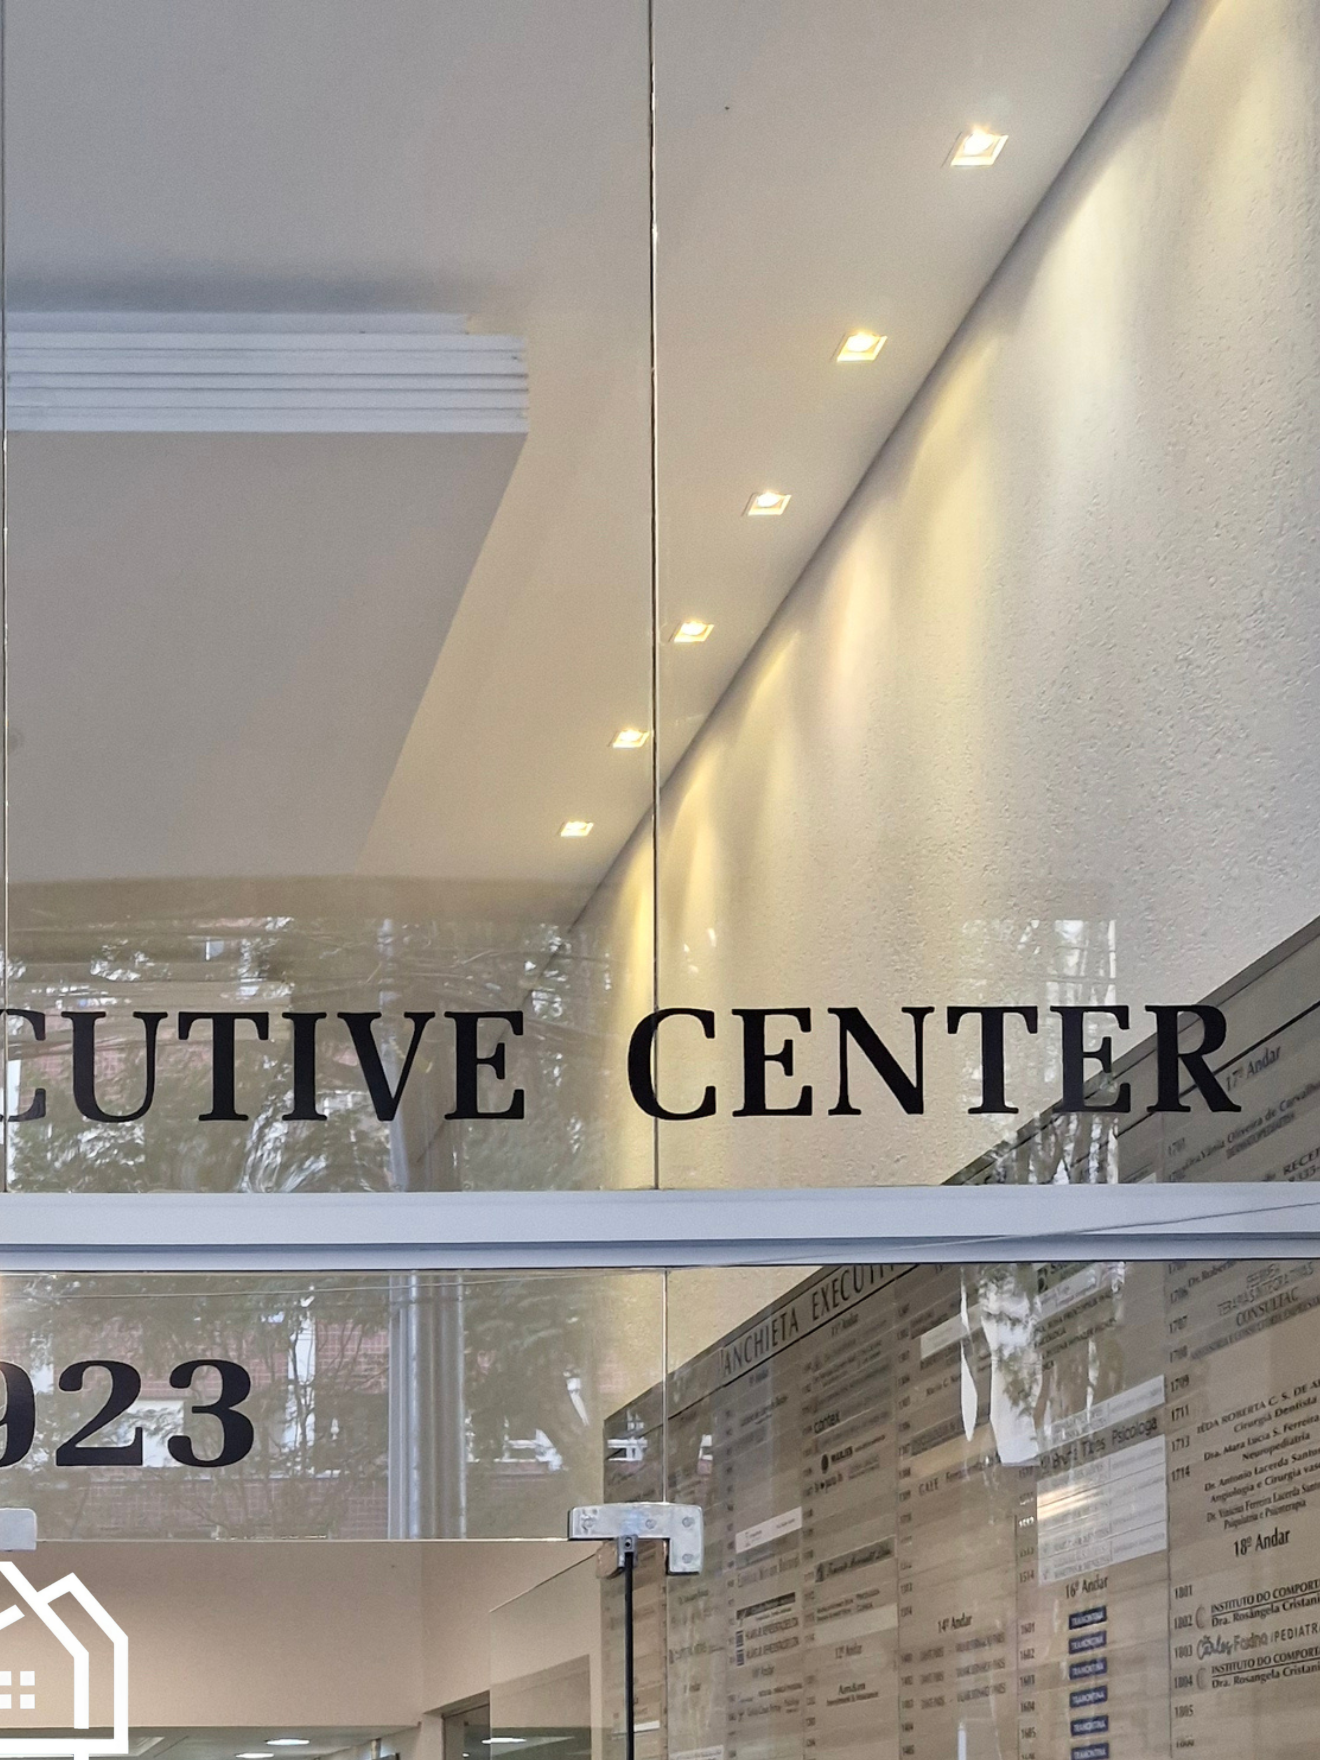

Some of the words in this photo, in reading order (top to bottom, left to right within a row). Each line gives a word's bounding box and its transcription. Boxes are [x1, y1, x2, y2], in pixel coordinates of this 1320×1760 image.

[627, 1004, 1241, 1120] CENTER
[723, 1308, 799, 1378] ANCHIETA
[1255, 1527, 1291, 1552] Andar
[1211, 1593, 1255, 1613] INSTITUTO
[1256, 1590, 1271, 1603] DO
[1211, 1615, 1231, 1628] Dra.
[1274, 1622, 1320, 1643] PEDIATR
[1212, 1658, 1256, 1674] INSTITUTO
[1257, 1654, 1272, 1665] DO
[1212, 1678, 1231, 1689] Dra.
